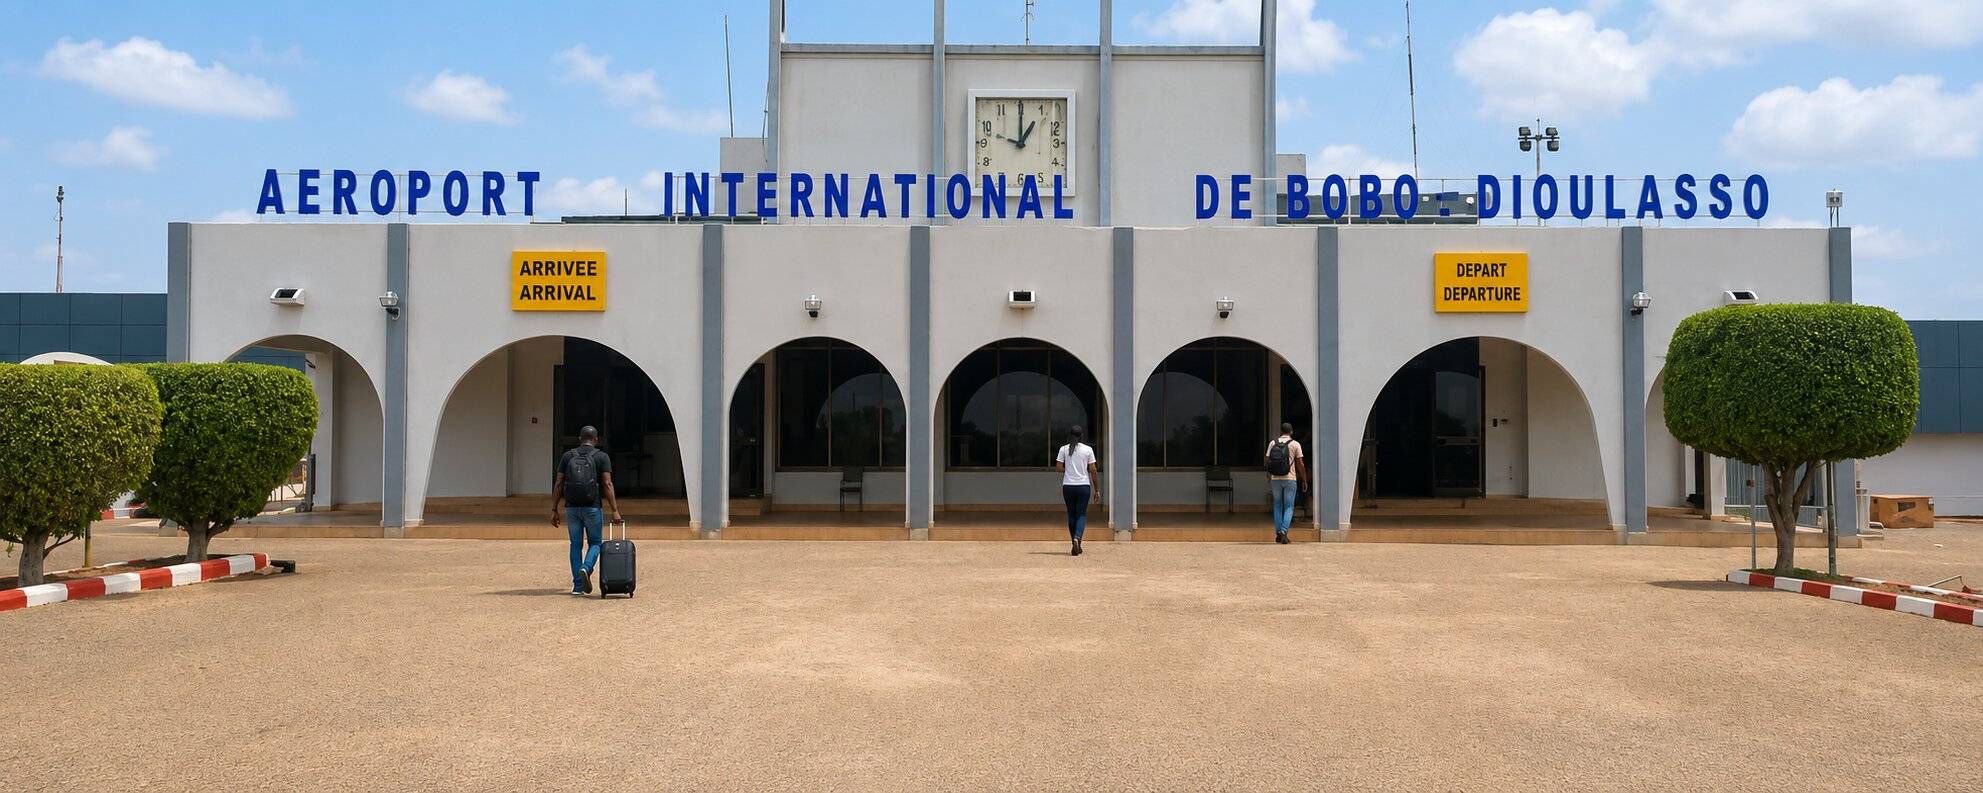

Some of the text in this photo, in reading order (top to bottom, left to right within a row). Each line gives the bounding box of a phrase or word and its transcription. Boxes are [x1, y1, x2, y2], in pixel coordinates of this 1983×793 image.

[997, 104, 1005, 116] 11
[1038, 104, 1044, 116] 1
[983, 157, 990, 167] 8
[257, 169, 540, 216] AEROPORT
[664, 172, 1073, 219] INTERNATIONAL
[1196, 175, 1252, 219] DE
[519, 261, 597, 276] ARRIVEE
[1456, 262, 1508, 278] DEPART
[519, 285, 596, 301] ARRIVAL
[1443, 286, 1521, 302] DEPARTURE
